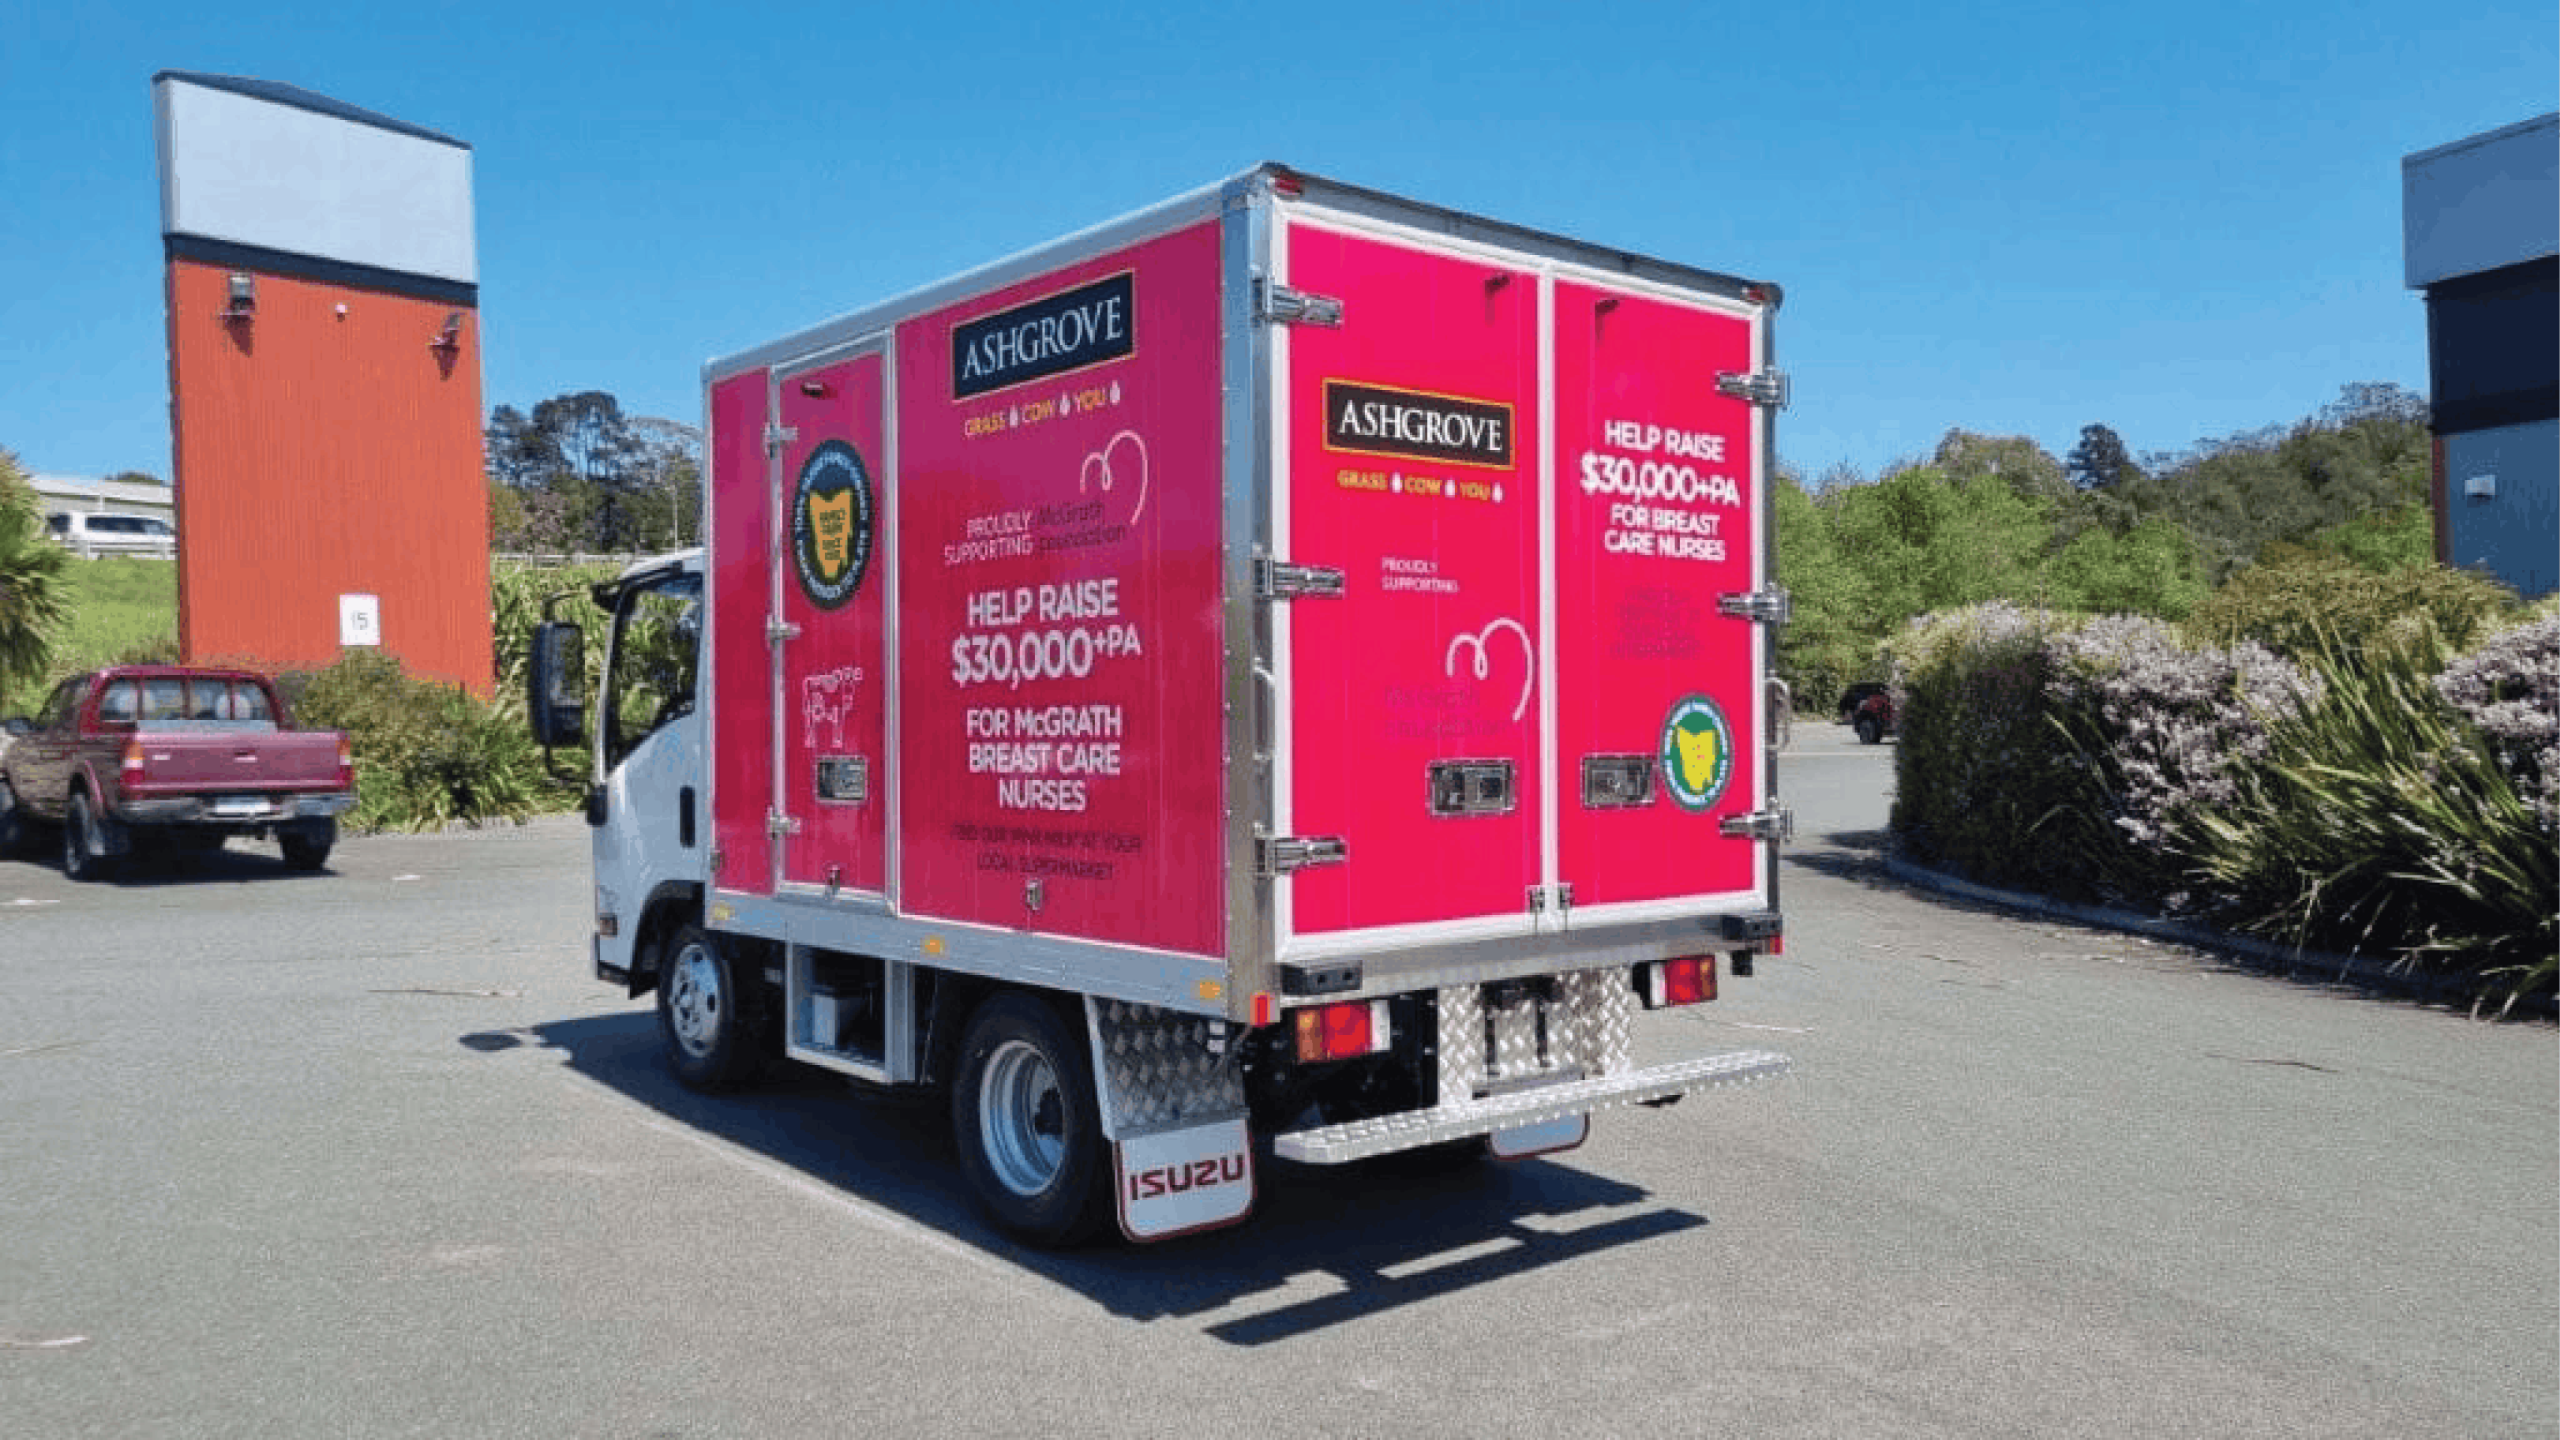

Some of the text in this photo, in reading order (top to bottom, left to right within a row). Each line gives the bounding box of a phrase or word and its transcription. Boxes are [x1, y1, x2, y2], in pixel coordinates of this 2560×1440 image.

[962, 295, 1123, 380] ASHGROVE
[965, 387, 1106, 436] GRASS COW YOU
[1338, 399, 1503, 452] ASHGROVE
[1604, 419, 1725, 463] HELP RAISE
[1337, 469, 1491, 501] GRASS COW YOU
[1580, 449, 1741, 508] $30,000+PA
[967, 510, 1033, 539] PROUDLY
[1610, 502, 1720, 536] FOR BREAST
[944, 533, 1034, 565] SUPPORTING
[1604, 529, 1725, 561] CARE NURSES
[1381, 555, 1438, 574] PROUDLY
[1381, 575, 1459, 594] SUPPORTING
[967, 577, 1119, 628] HELP RAISE
[952, 622, 1143, 691] $30,000+PA
[966, 706, 1010, 738] FOR
[969, 742, 1121, 776] BREAST CARE
[999, 779, 1087, 811] NURSES
[1130, 1153, 1244, 1200] ISUZU
